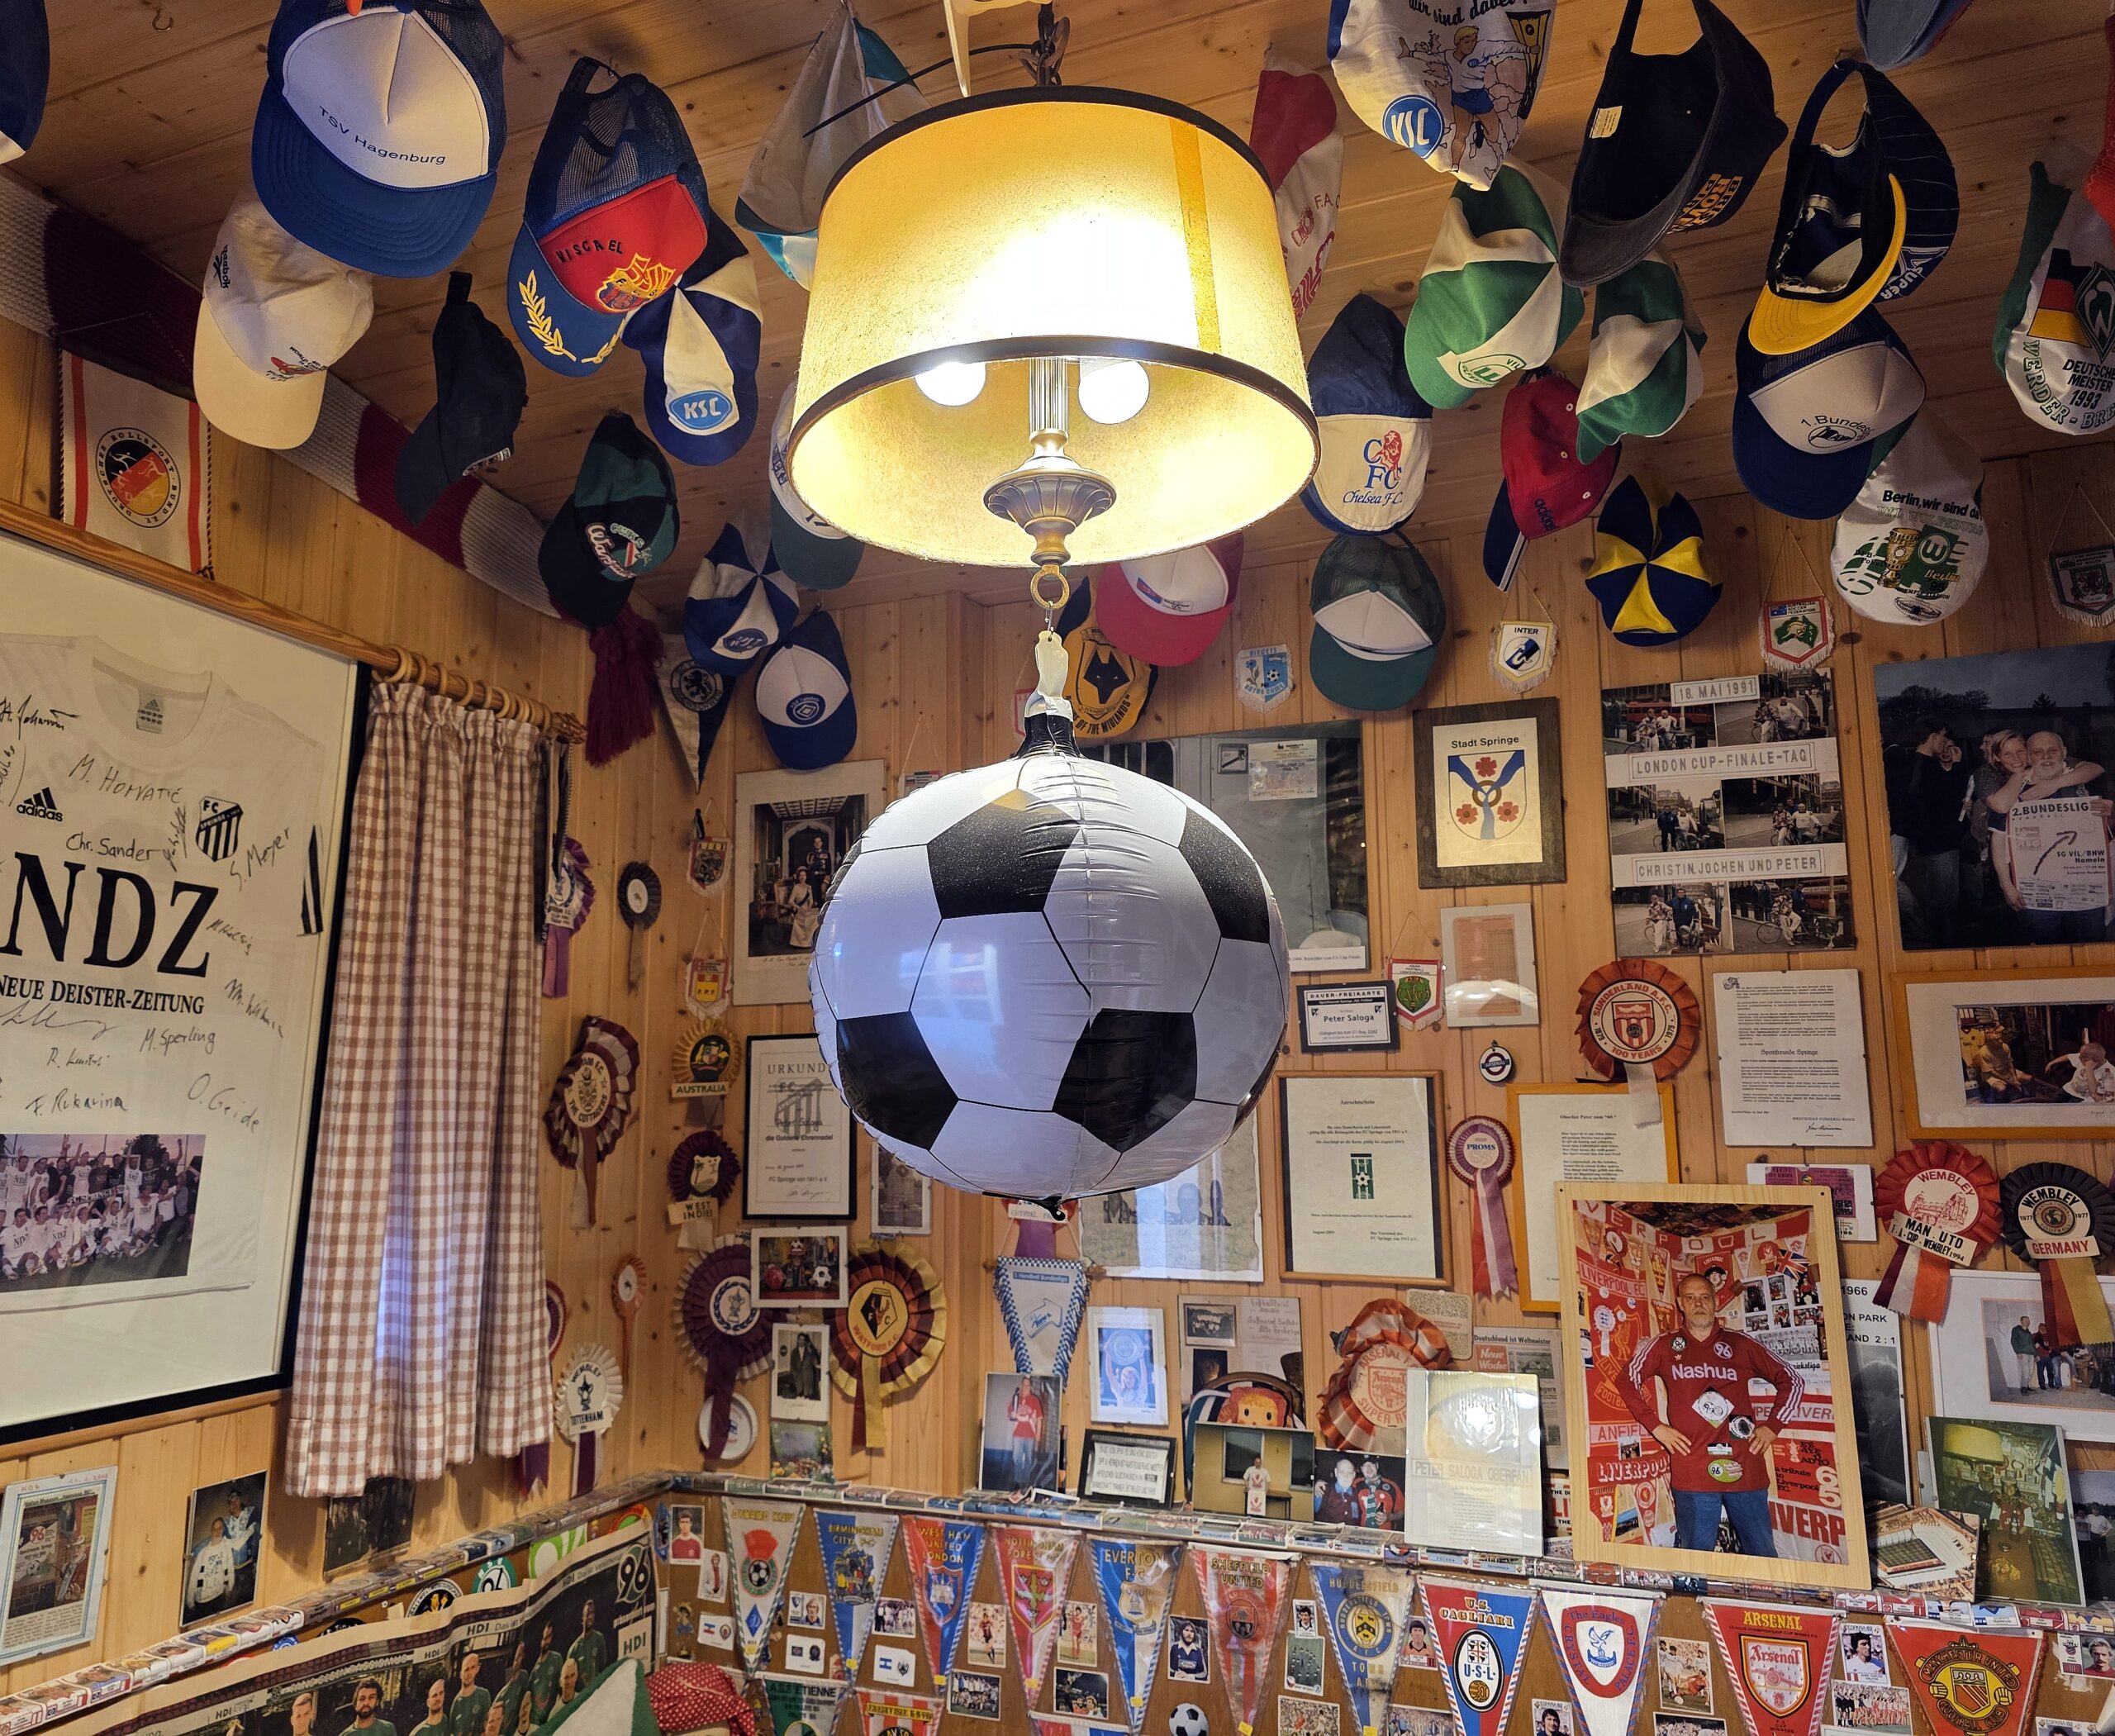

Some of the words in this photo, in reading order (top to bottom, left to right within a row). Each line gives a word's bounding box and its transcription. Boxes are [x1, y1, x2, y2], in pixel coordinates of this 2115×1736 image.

[1433, 7, 1465, 26] sind
[319, 106, 349, 136] TSV
[354, 133, 447, 166] Hagenburg
[1390, 107, 1430, 149] KSC
[556, 238, 605, 264] VISCA
[608, 239, 623, 254] EL
[1880, 265, 1924, 300] SUPER
[2067, 373, 2113, 392] MEISTER
[2070, 389, 2103, 410] 1993
[683, 397, 722, 420] KSC
[1343, 489, 1382, 504] Chelsea
[1534, 498, 1559, 531] adidas
[1942, 501, 1969, 516] sind
[1514, 625, 1539, 635] INTER
[1679, 687, 1694, 701] 18.
[1698, 684, 1723, 699] MAI
[1726, 680, 1754, 696] 1991
[1076, 721, 1086, 731] OF
[1088, 724, 1100, 735] THE
[1452, 739, 1478, 749] Stadt
[1480, 735, 1520, 749] Springe
[1637, 758, 1688, 775] LONDON
[1692, 749, 1808, 770] CUP-FINALE-TAG
[17, 802, 63, 822] adidas
[65, 832, 93, 853] Chr.
[99, 839, 155, 862] Sander
[247, 827, 289, 878] Meyer
[1698, 861, 1745, 874] JOCHEN
[1749, 858, 1772, 872] UND
[1777, 857, 1817, 870] PETER
[0, 851, 219, 978] NDZ
[0, 974, 45, 1000] NEUE
[51, 978, 205, 1015] DEISTER-ZEITUNG
[1310, 991, 1381, 999] DAUER-FREIKARTE
[1593, 982, 1650, 1017] SUNDERLAND
[1651, 989, 1673, 1015] A.F.C.
[1324, 1013, 1345, 1022] Peter
[1347, 1013, 1375, 1024] Saloga
[1594, 1027, 1605, 1042] 1879
[1665, 1024, 1675, 1039] 1979
[159, 1026, 216, 1055] Sperling
[1612, 1046, 1629, 1058] 100
[1630, 1044, 1663, 1059] YEARS
[767, 1063, 826, 1074] URKUND
[676, 1085, 726, 1094] AUSTRALIA
[1917, 1171, 1976, 1196] WEMBLEY
[685, 1201, 711, 1210] WEST
[2021, 1187, 2080, 1209] WEMBLEY
[683, 1209, 713, 1220] INDIES
[1904, 1217, 1932, 1238] MAN
[1939, 1230, 1964, 1250] UTD
[1906, 1231, 1918, 1244] CUP
[1923, 1239, 1951, 1258] WEMBLEY
[1949, 1252, 1965, 1262] 1994
[2031, 1240, 2089, 1255] GERMANY
[1582, 1263, 1633, 1295] LIVERPOOL
[1858, 1313, 1887, 1323] PARK
[853, 1324, 887, 1352] WATFORD
[1474, 1334, 1509, 1343] Deutschland
[1518, 1336, 1551, 1345] Weltmeister
[1361, 1348, 1401, 1370] ARSENAL
[1480, 1348, 1504, 1359] Neue
[1714, 1343, 1732, 1358] 96
[1478, 1359, 1507, 1370] Woche
[1671, 1363, 1737, 1382] Nashua
[570, 1410, 604, 1426] TOTTENHAM
[1357, 1398, 1391, 1424] SUPER
[1414, 1461, 1444, 1476] PETER
[1448, 1463, 1484, 1480] SALOGA
[1710, 1466, 1720, 1475] 96
[1782, 1467, 1811, 1477] tribute
[1776, 1477, 1818, 1491] Liverpool
[31, 1528, 45, 1542] 96
[829, 1523, 885, 1537] BIRMINGHAM
[920, 1526, 943, 1538] WEST
[948, 1529, 972, 1541] HAM
[833, 1535, 853, 1545] CITY
[925, 1539, 962, 1552] UNITED
[922, 1550, 964, 1564] LONDON
[1104, 1548, 1167, 1567] EVERTON
[618, 1545, 651, 1603] 96
[1212, 1558, 1271, 1575] SHEFFIELD
[1221, 1575, 1265, 1588] UNITED
[1328, 1577, 1400, 1594] HUDDERSFIELD
[1464, 1596, 1491, 1612] U.S.
[1438, 1607, 1515, 1629] CAGLIARI
[1570, 1610, 1589, 1620] The
[1590, 1610, 1626, 1625] Eagles
[1743, 1610, 1804, 1631] ARSENAL
[467, 1622, 490, 1636] HDI
[624, 1632, 647, 1650] HDI
[425, 1650, 440, 1659] HDI
[1564, 1624, 1590, 1686] CRYSTAL
[1749, 1644, 1802, 1666] Arsenal
[1352, 1661, 1385, 1674] TOWN
[1614, 1652, 1637, 1691] PALACE
[1923, 1648, 1982, 1677] MANCHESTER
[1985, 1655, 2018, 1689] UNITED
[215, 1708, 232, 1719] HDI
[1940, 1700, 1979, 1731] FOOTBALL
[1984, 1705, 2008, 1729] CLUB
